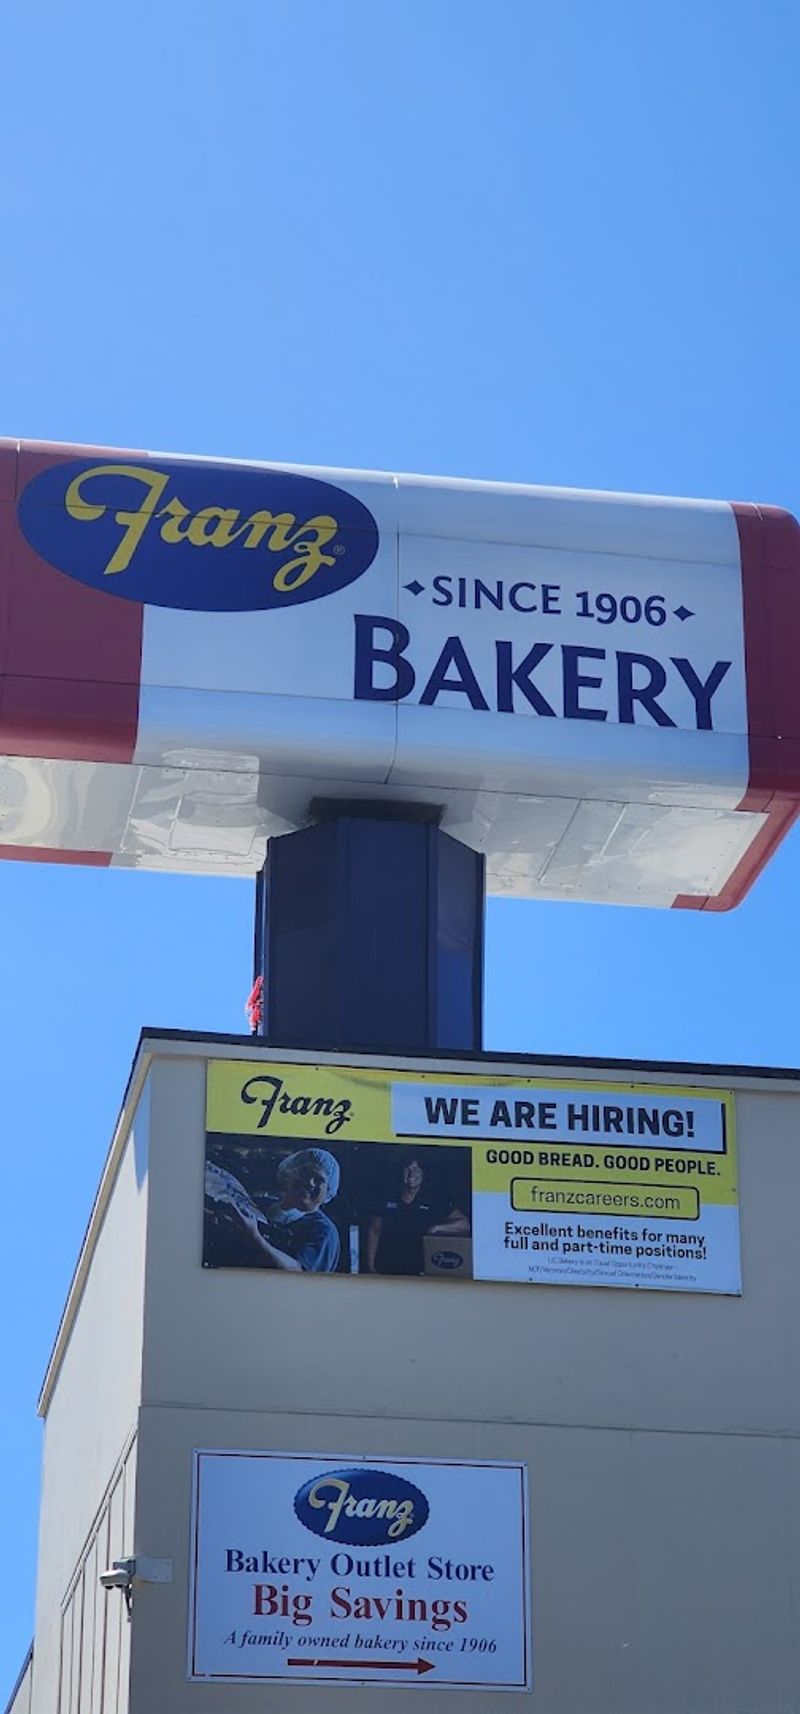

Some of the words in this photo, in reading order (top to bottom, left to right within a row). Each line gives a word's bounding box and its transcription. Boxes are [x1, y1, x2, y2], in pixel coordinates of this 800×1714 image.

[65, 465, 339, 592] Franz
[432, 576, 561, 615] SINCE
[575, 592, 667, 627] 1906
[354, 614, 732, 731] BAKERY
[241, 1075, 352, 1135] Franz
[424, 1096, 480, 1126] WE
[489, 1099, 557, 1129] ARE
[567, 1103, 695, 1137] HIRING!
[486, 1149, 534, 1165] GOOD
[539, 1151, 599, 1168] BREAD.
[604, 1154, 650, 1171] GOOD
[655, 1158, 721, 1175] PEOPLE.
[530, 1185, 681, 1210] franzcareers.com
[503, 1235, 528, 1250] full
[532, 1238, 559, 1251] and
[563, 1239, 632, 1255] part-time
[636, 1243, 707, 1260] positions!
[504, 1221, 573, 1238] Excellent
[577, 1225, 638, 1242] benefits
[642, 1228, 663, 1243] for
[666, 1232, 705, 1247] many
[307, 1477, 415, 1538] Franz
[224, 1548, 322, 1582] Bakery
[330, 1552, 417, 1580] Outlet
[427, 1555, 496, 1582] Store
[252, 1583, 313, 1626] Big
[330, 1586, 469, 1632] Savings
[223, 1631, 237, 1645] A
[239, 1629, 293, 1650] family
[297, 1632, 350, 1649] owned
[354, 1634, 411, 1653] bakery
[412, 1636, 454, 1652] since
[460, 1637, 498, 1654] 1906
